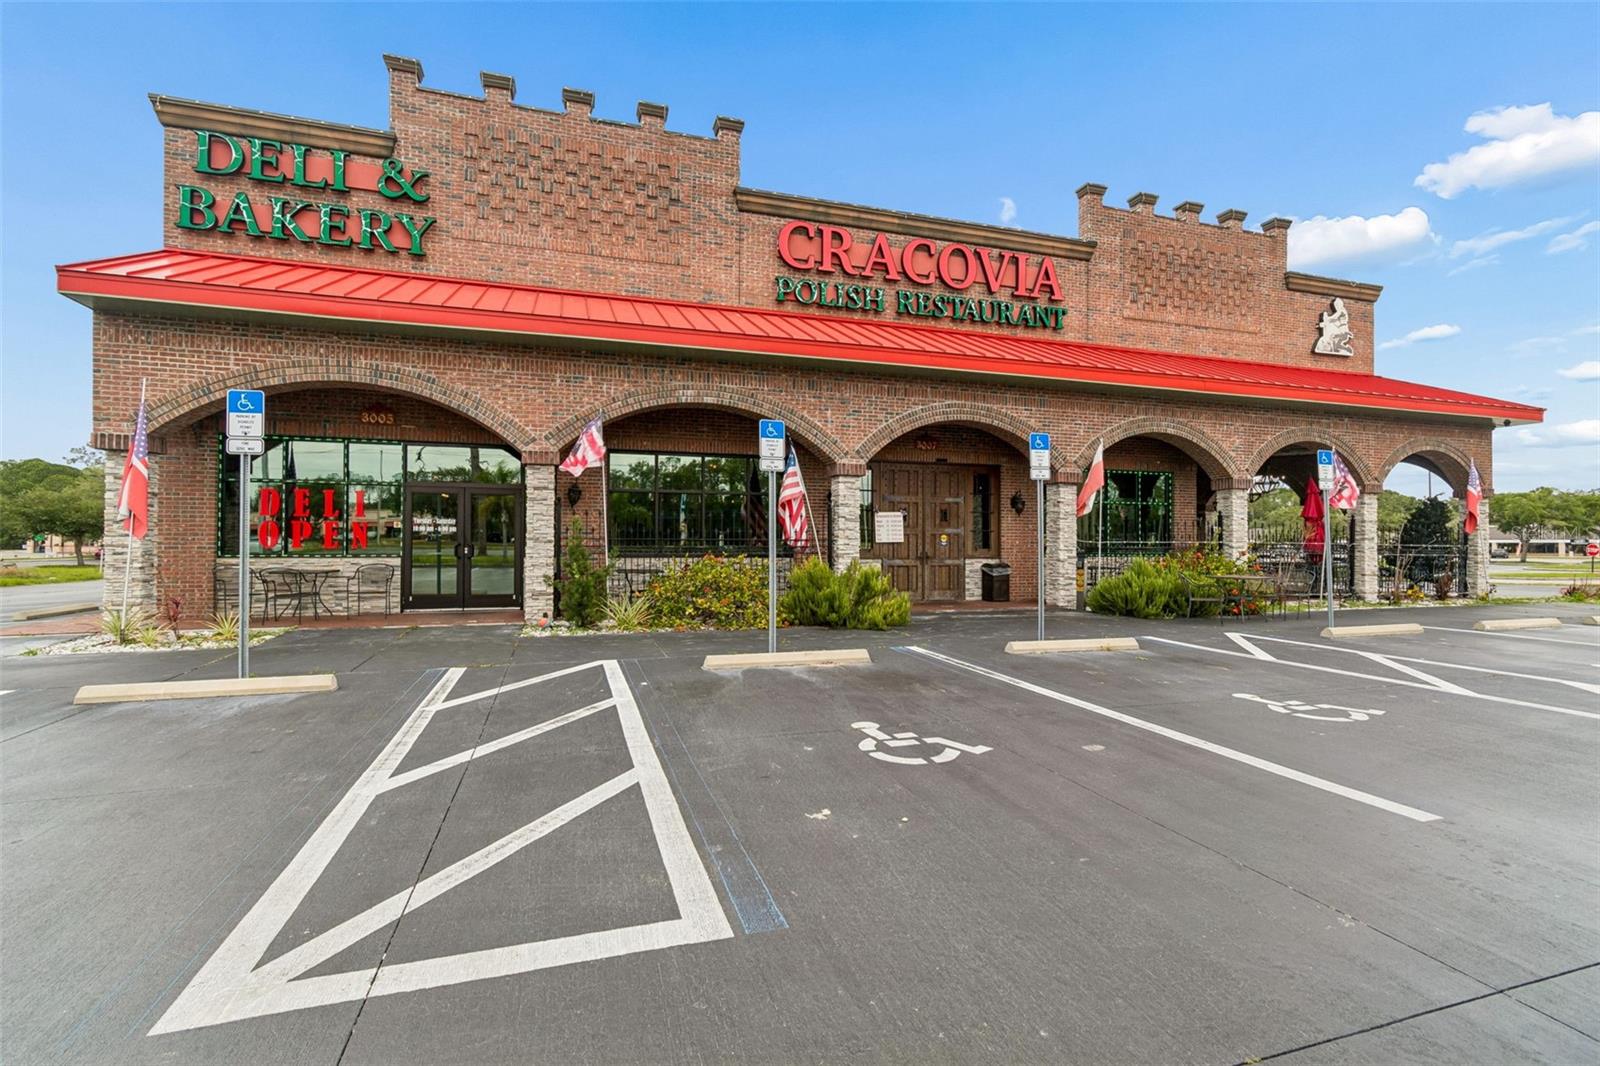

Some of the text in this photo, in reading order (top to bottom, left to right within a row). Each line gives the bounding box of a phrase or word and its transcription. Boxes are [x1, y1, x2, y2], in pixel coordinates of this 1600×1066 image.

[193, 130, 431, 203] DELI &
[175, 184, 438, 256] BAKERY
[777, 220, 1065, 301] CRACOVIA
[775, 276, 1069, 330] POLISH RESTAURANT
[361, 412, 394, 425] 3005
[258, 487, 366, 518] DELI
[257, 520, 369, 550] OPEN
